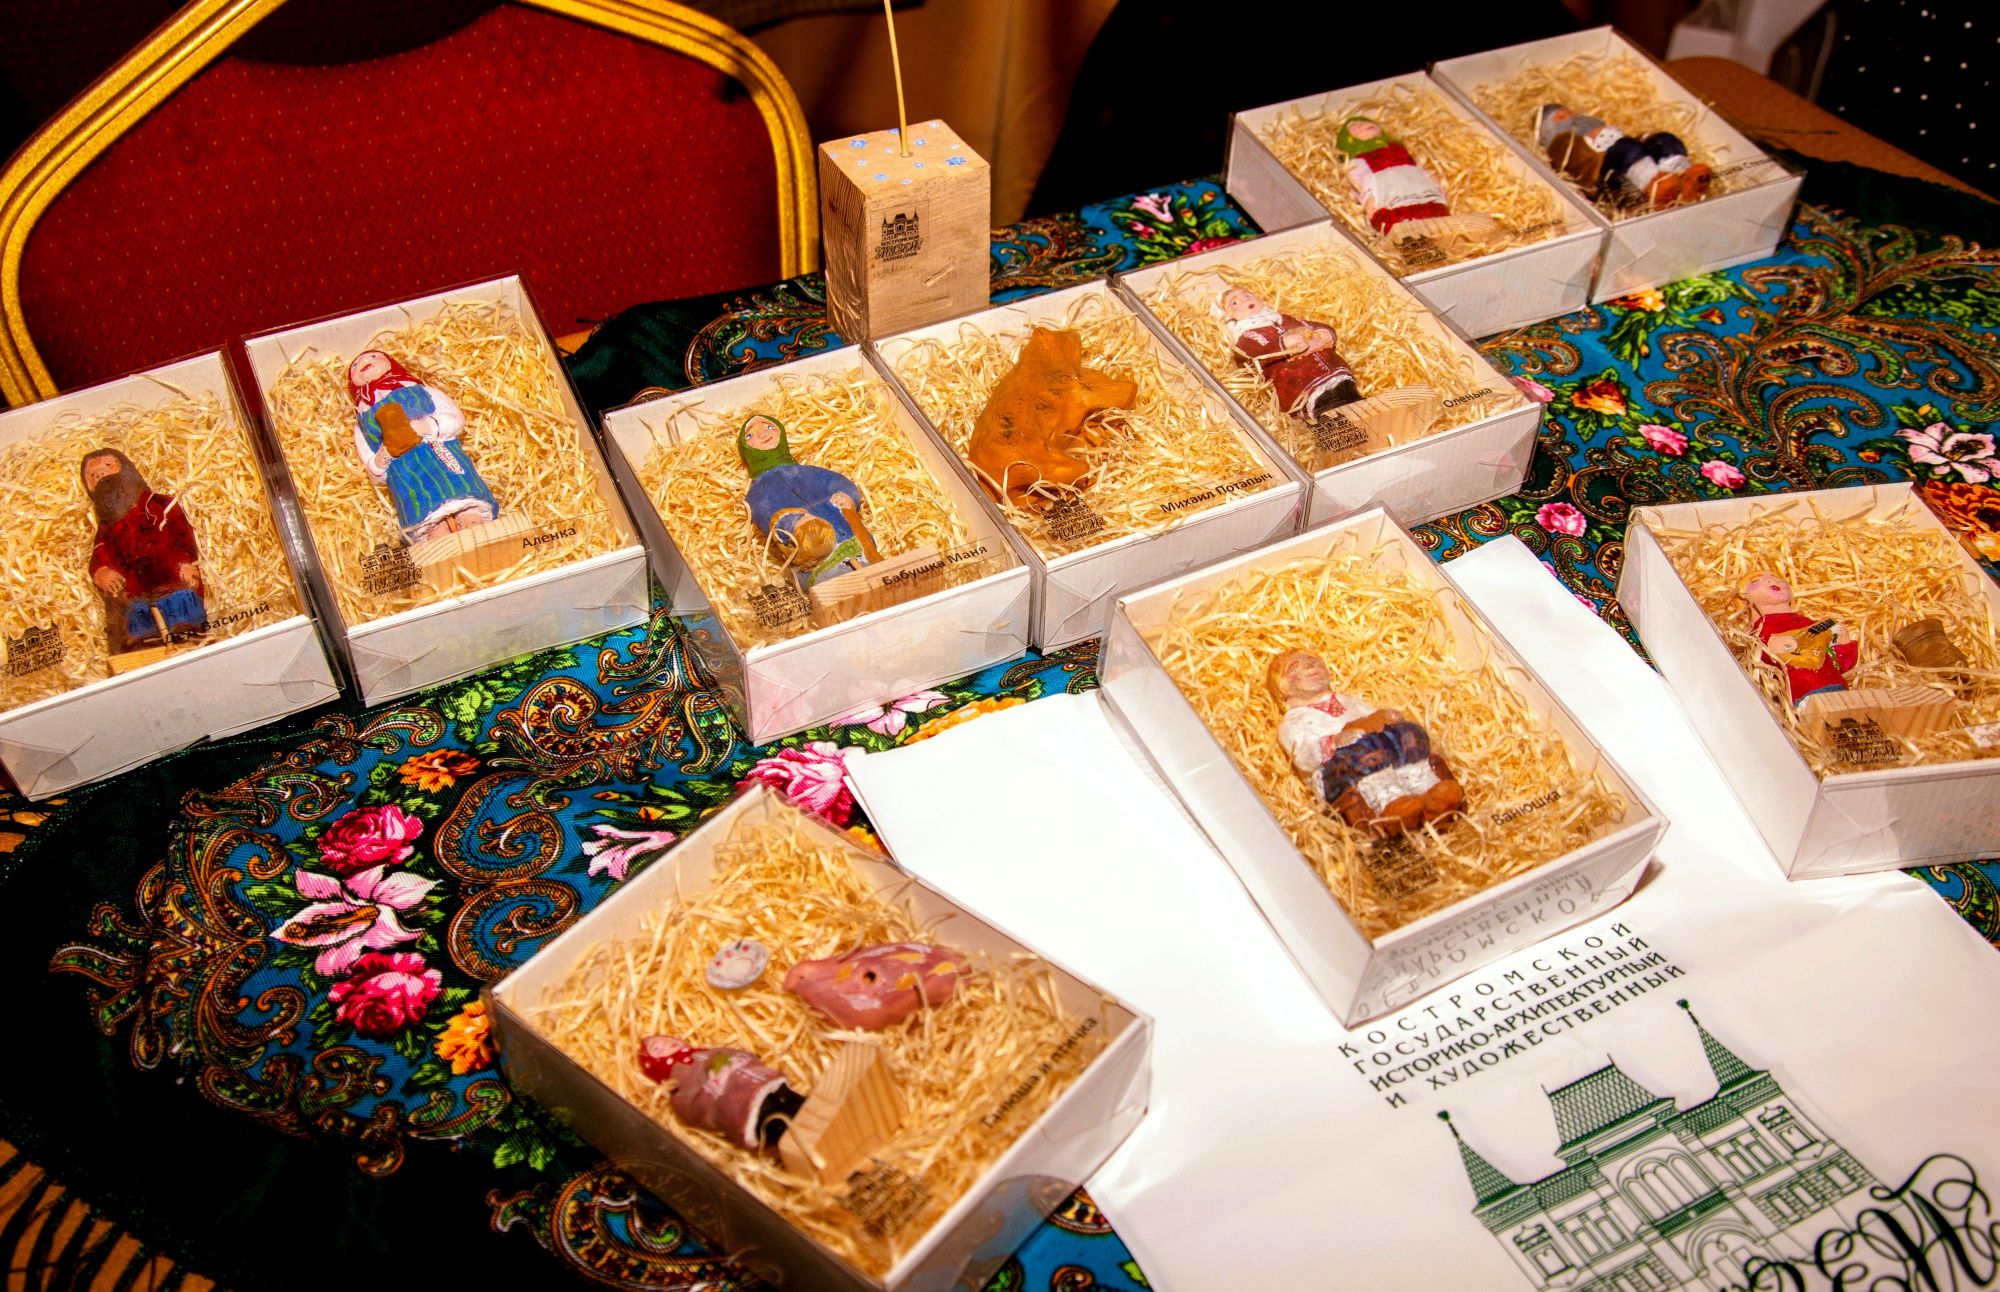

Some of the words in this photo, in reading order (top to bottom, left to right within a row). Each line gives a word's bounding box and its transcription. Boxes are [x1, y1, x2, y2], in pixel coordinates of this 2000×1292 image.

[1443, 387, 1493, 408] Оленька
[1160, 491, 1215, 514] Михаил
[1215, 472, 1273, 497] Потапыч
[522, 526, 577, 549] Аленка
[882, 559, 946, 586] Бабушка
[947, 545, 988, 564] Маня
[162, 627, 197, 646] Дед
[202, 602, 270, 632] Василий
[1491, 788, 1562, 827] Ванюшка
[1338, 922, 1633, 1059] КОСТРОМСКОЙ
[1353, 937, 1650, 1075] ГОСУДАРСТВЕННЫЙ
[1370, 951, 1668, 1092] ИСТОРИКО-АРХИТЕКТУРНЫЙ
[1385, 1092, 1407, 1109] И
[1425, 965, 1687, 1091] ХУДОЖЕСТВЕННЫЙ
[1040, 1063, 1051, 1076] и
